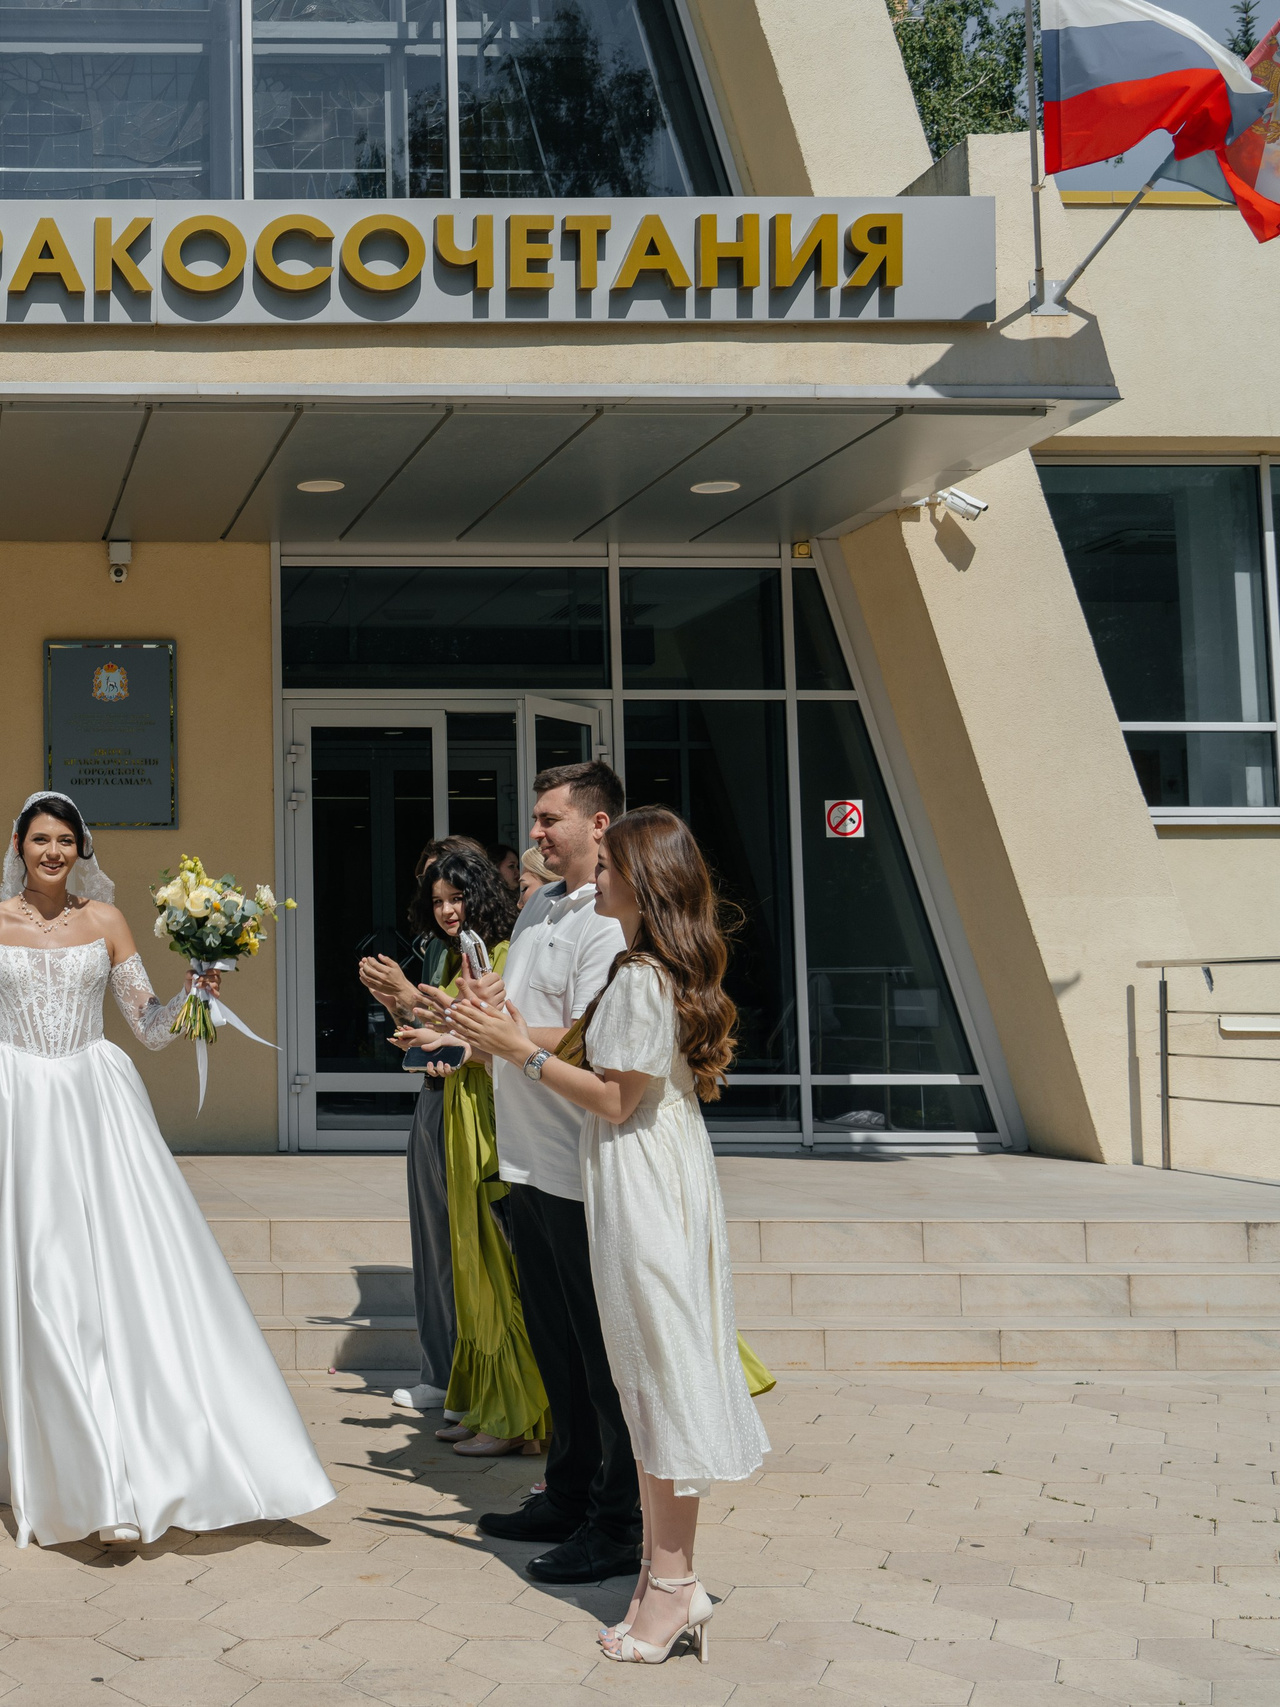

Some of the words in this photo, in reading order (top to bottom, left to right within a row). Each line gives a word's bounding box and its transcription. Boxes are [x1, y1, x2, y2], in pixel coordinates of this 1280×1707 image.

[78, 768, 145, 776] ГОРОДСКОГО
[70, 778, 110, 786] ОКРУГА
[111, 778, 153, 786] САМАРА
